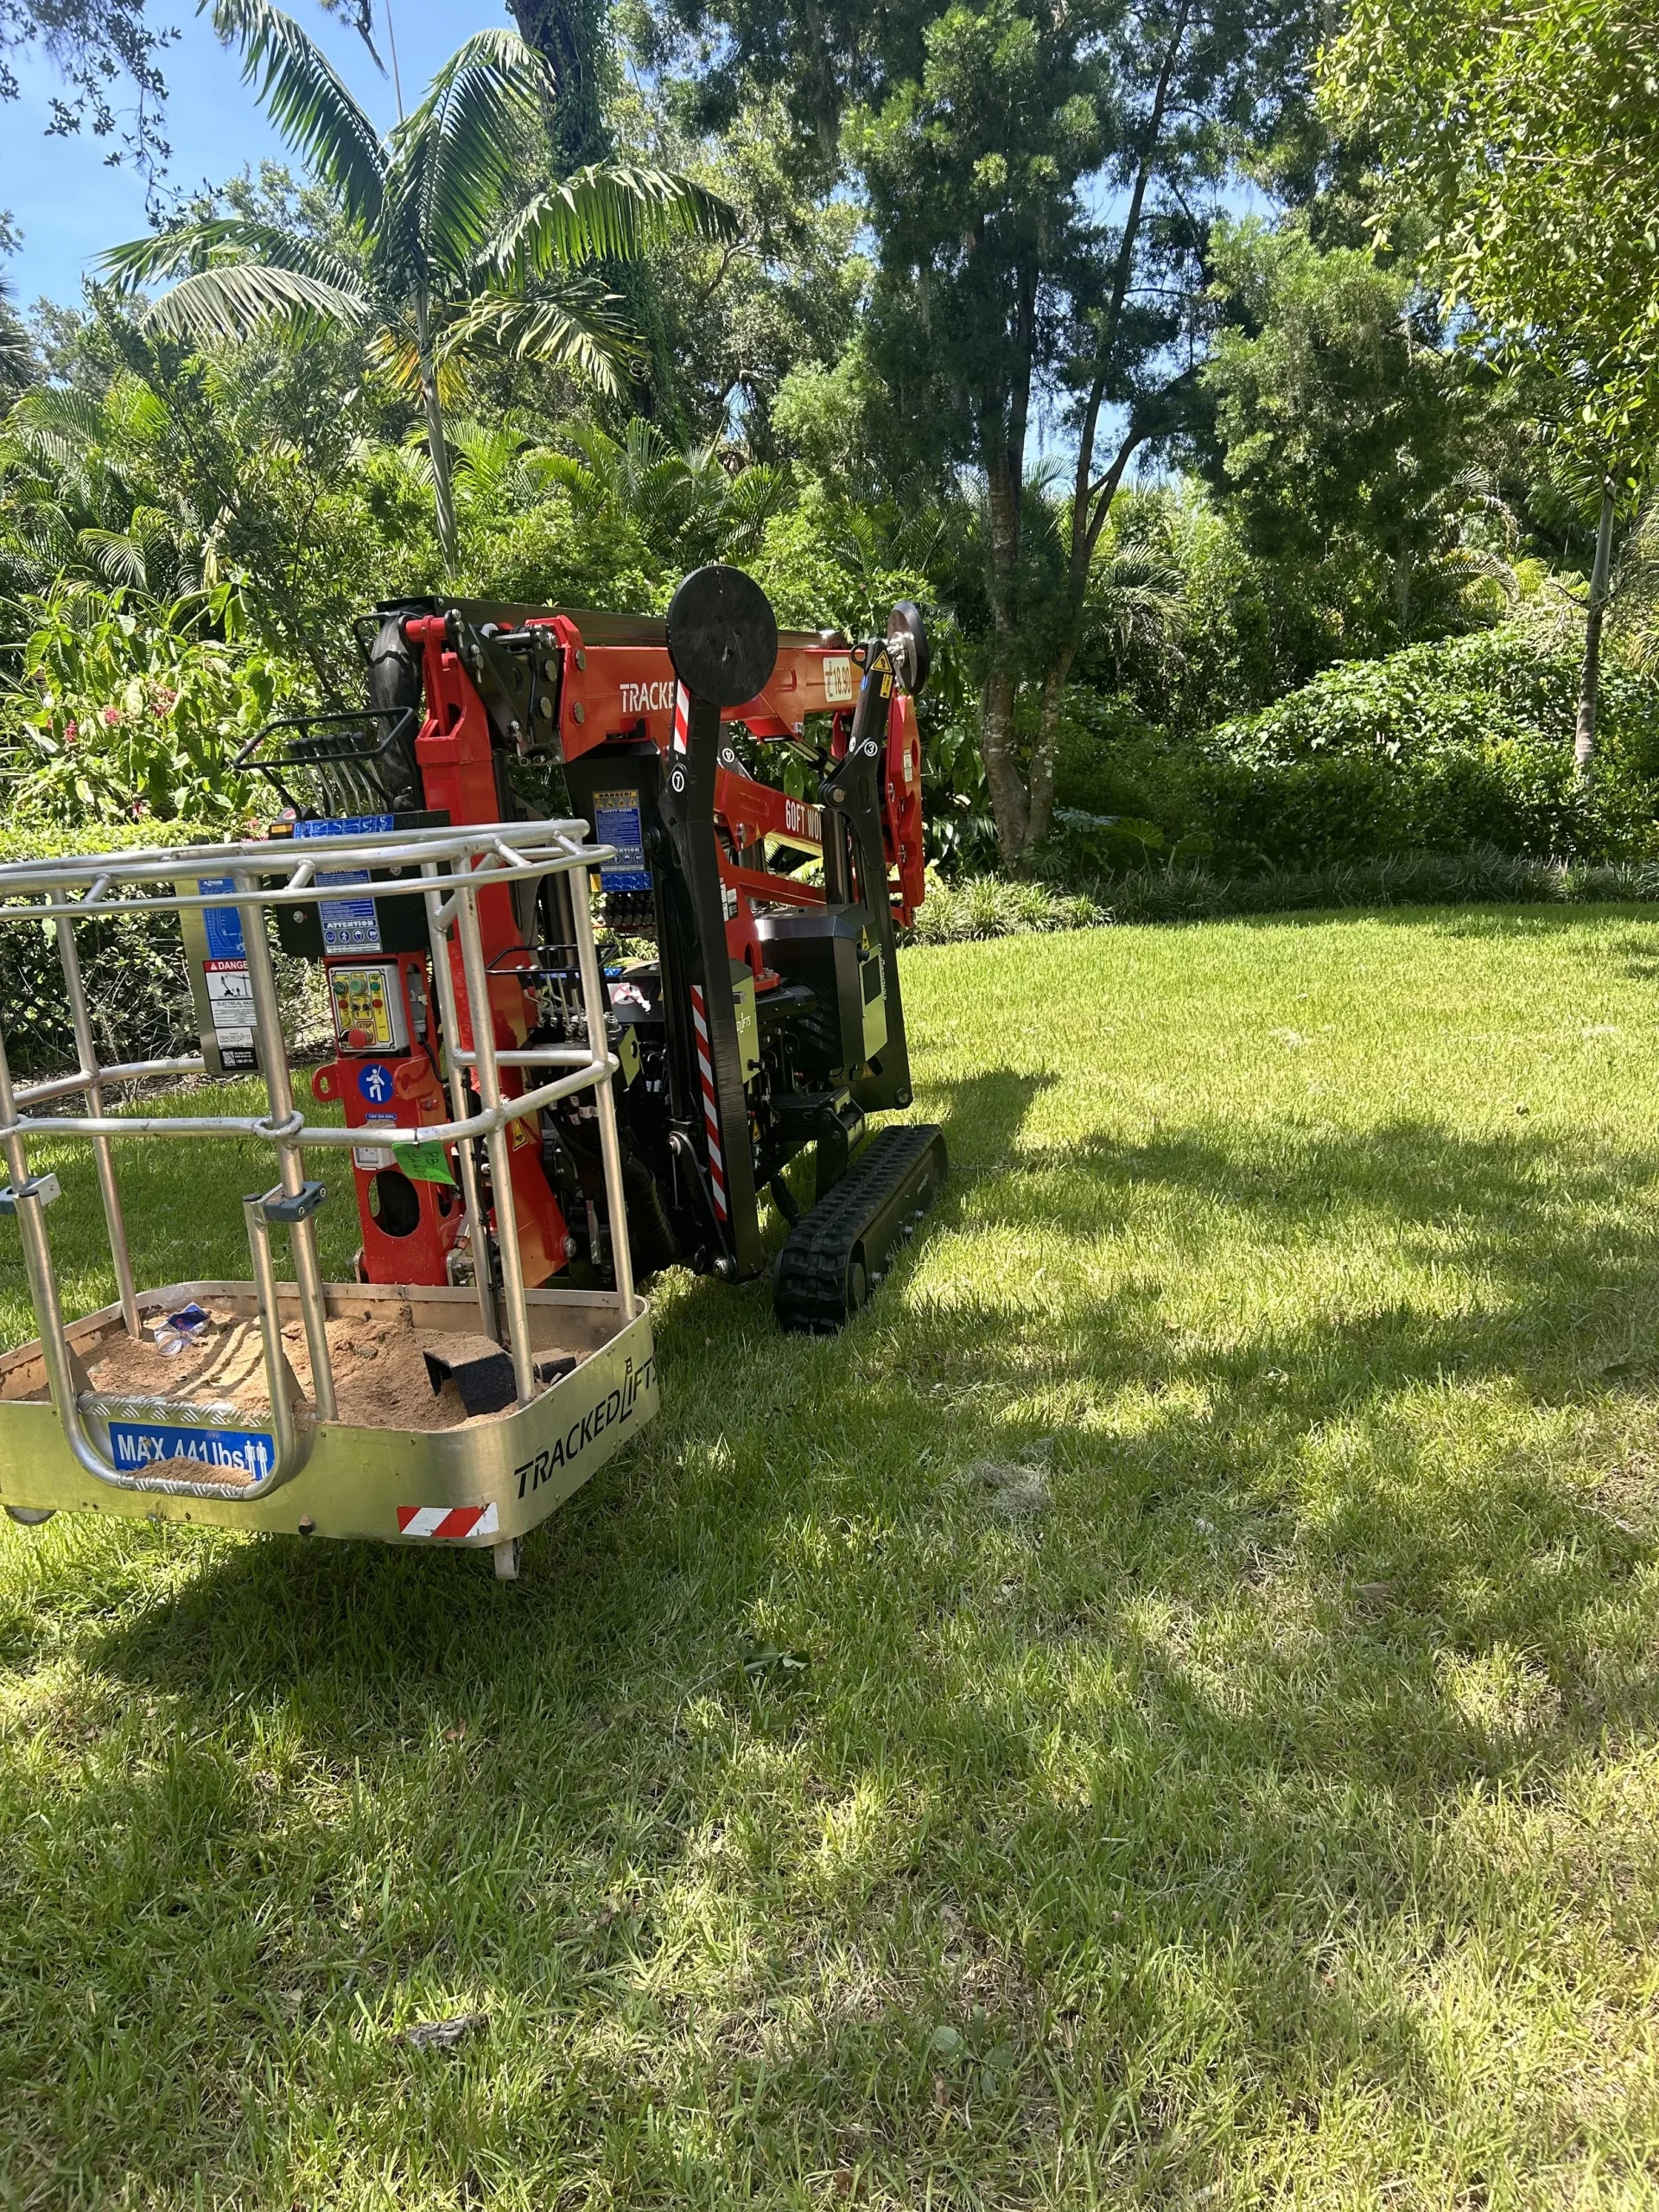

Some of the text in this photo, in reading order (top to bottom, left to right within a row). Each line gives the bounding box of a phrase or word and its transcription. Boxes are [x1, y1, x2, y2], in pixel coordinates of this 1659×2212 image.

[833, 666, 851, 696] 18.90
[620, 681, 674, 713] TRACKE
[785, 798, 805, 836] 60FT
[327, 919, 374, 929] ATTENTION
[218, 960, 250, 970] DANGE
[118, 1433, 166, 1462] MAX
